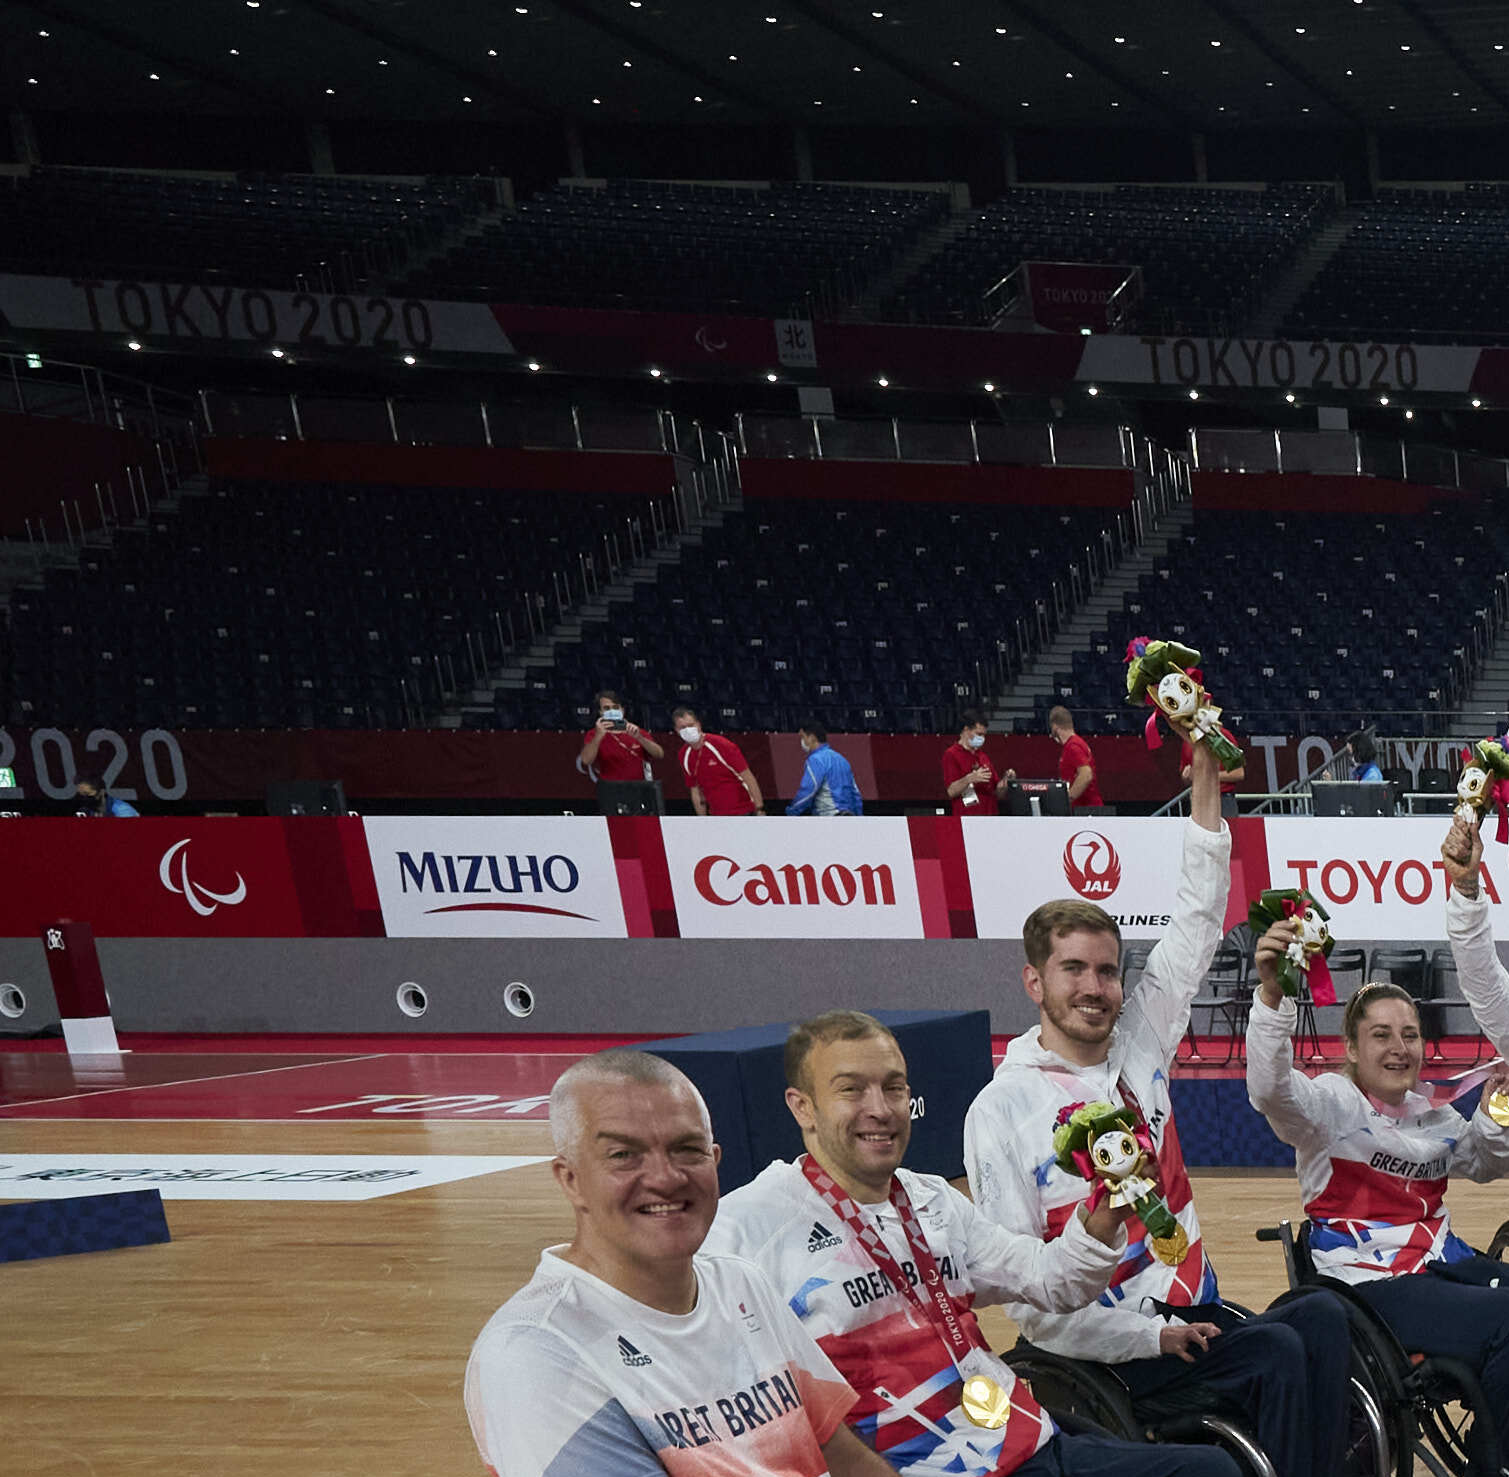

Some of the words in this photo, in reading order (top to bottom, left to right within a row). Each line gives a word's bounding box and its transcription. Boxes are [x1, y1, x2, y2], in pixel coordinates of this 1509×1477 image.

[73, 279, 277, 343] TOKYO
[292, 294, 433, 350] 2020
[1140, 336, 1297, 389] TOKYO
[1308, 341, 1418, 391] 2020
[396, 851, 580, 894] MIZUHO
[693, 855, 896, 906] Canon
[1081, 880, 1113, 893] JAL
[1370, 1151, 1417, 1177] GREAT
[807, 1236, 842, 1253] adidas
[843, 1269, 893, 1308] GREA
[935, 1292, 952, 1315] 2020
[945, 1315, 964, 1346] TOKYO
[716, 1370, 802, 1437] BRITAI
